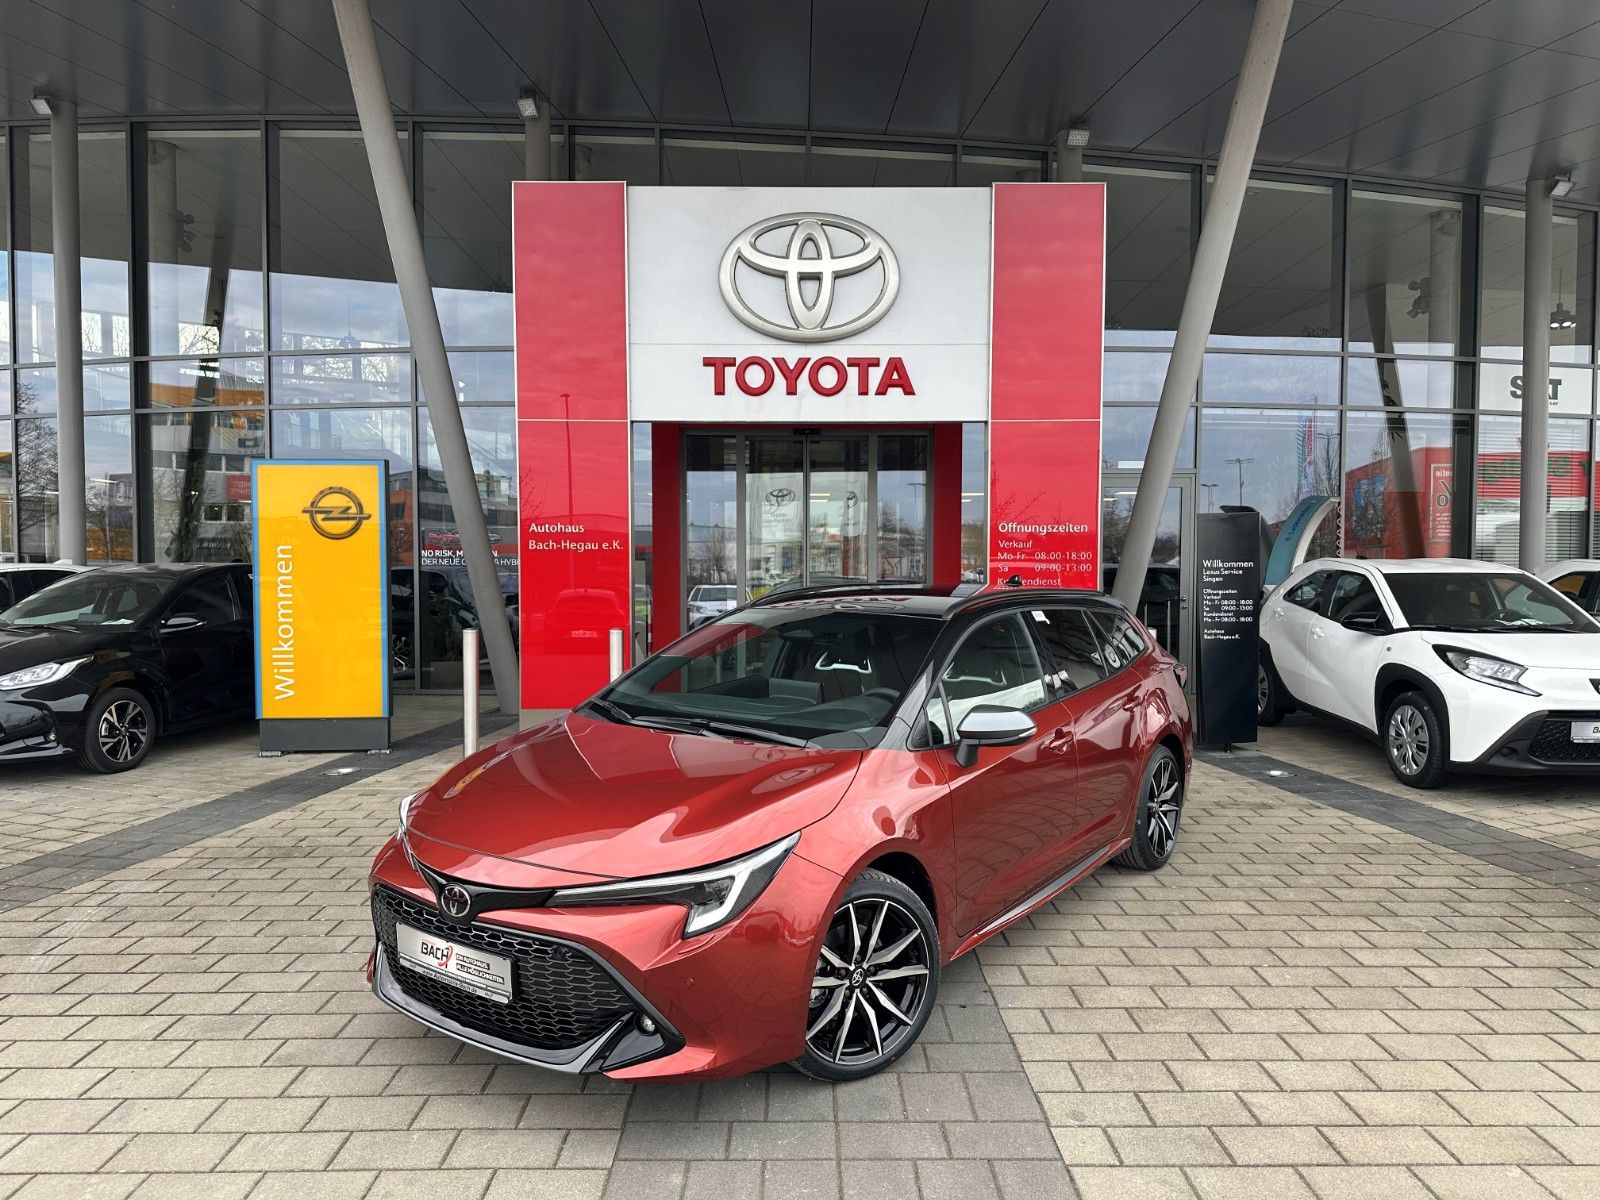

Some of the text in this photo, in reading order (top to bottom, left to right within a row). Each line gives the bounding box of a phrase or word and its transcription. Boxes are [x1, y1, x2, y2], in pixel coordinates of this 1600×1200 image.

[703, 356, 915, 396] TOYOTA
[1510, 376, 1562, 399] ST
[529, 522, 584, 532] Autohaus
[998, 520, 1088, 535] Öffnungszeiten
[529, 540, 624, 552] Bach-Hegau e.K.
[998, 540, 1033, 548] Verkauf
[435, 550, 455, 558] RISK,
[997, 552, 1092, 560] Mo-Fr 08:00-18:00
[998, 564, 1092, 572] Sa 09:00-13:00
[1203, 559, 1254, 567] Willkommen
[270, 545, 294, 700] Willkommen
[421, 942, 449, 967] BACH
